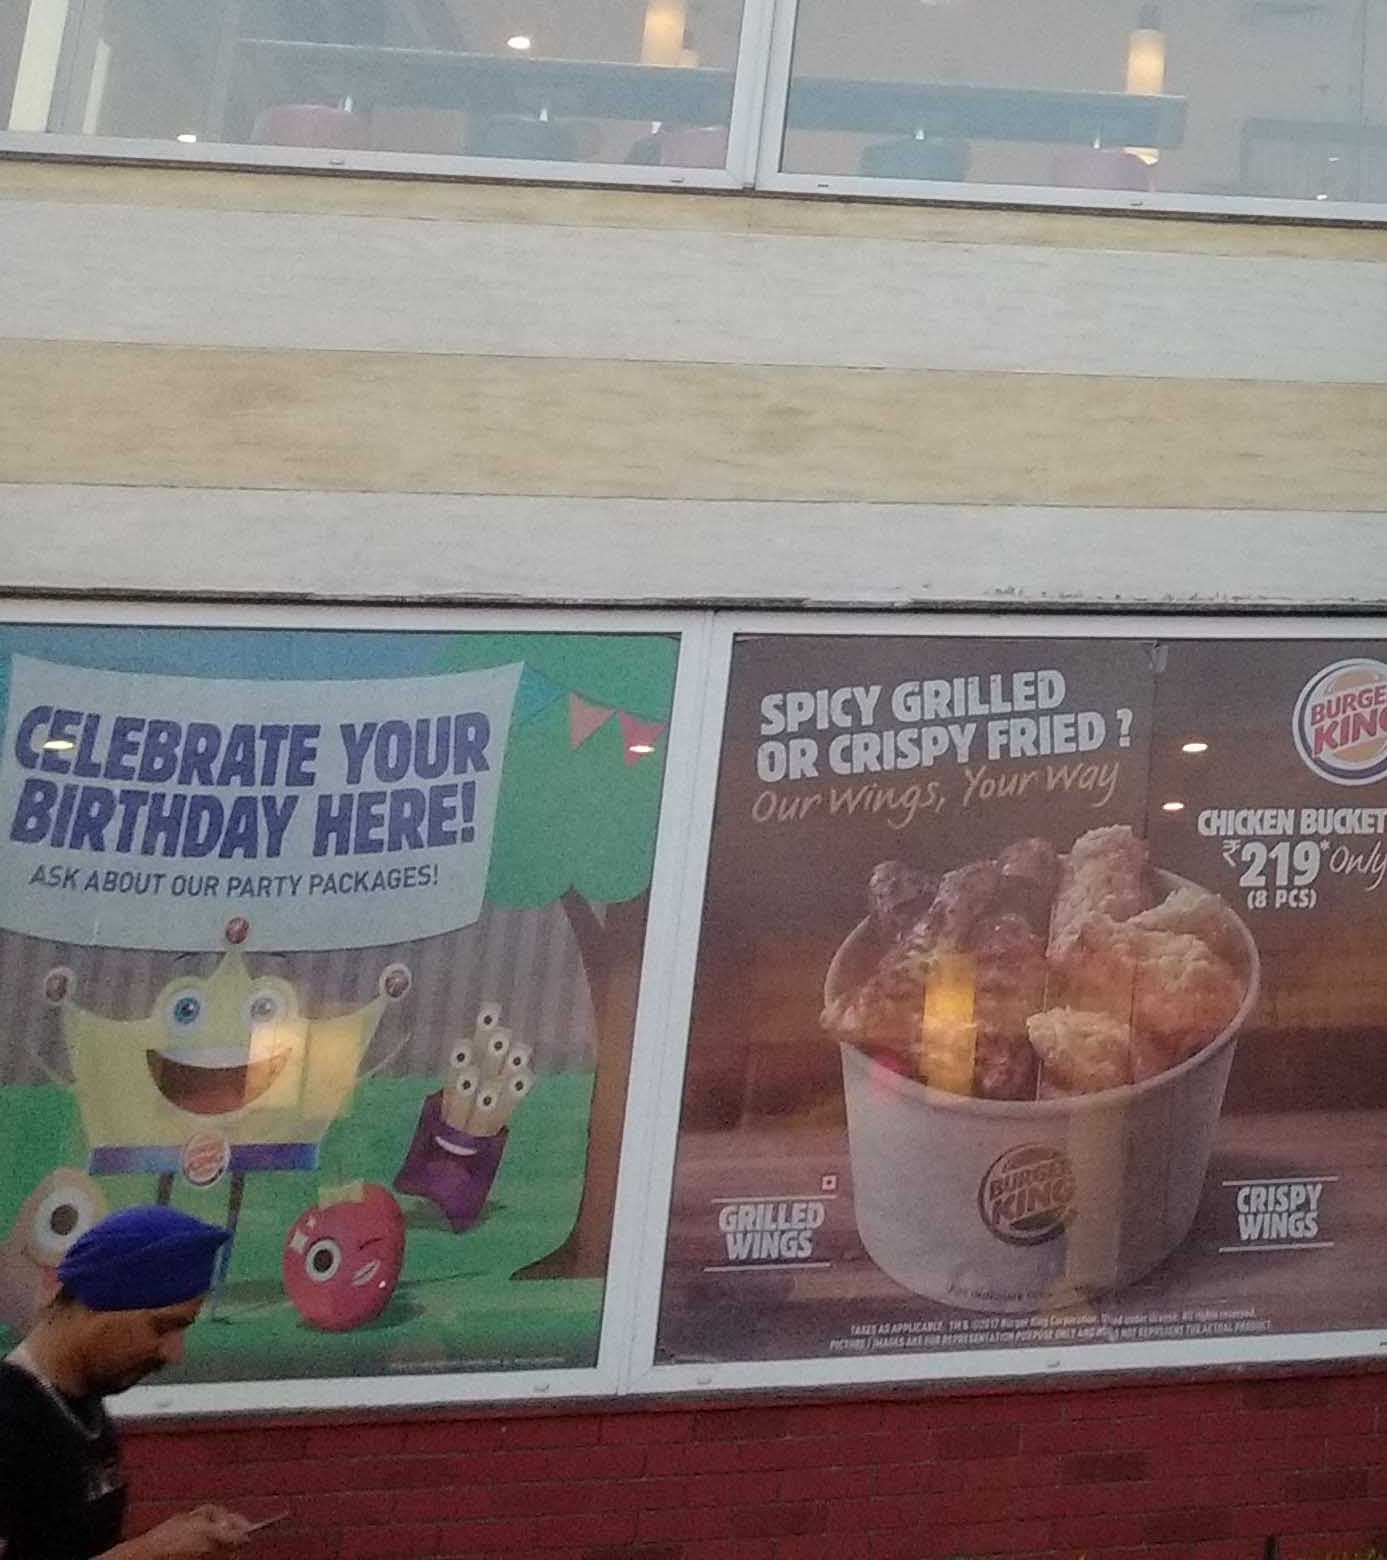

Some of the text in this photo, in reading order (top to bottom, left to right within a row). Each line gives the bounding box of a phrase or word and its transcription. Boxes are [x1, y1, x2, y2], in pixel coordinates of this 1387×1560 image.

[760, 669, 1066, 735] SPICY GRILLED
[14, 704, 491, 787] CELEBRATE YOUR
[757, 738, 818, 783] OR
[829, 722, 977, 775] CRISPY
[988, 712, 1106, 761] FRIED
[751, 790, 821, 824] Our
[962, 766, 1037, 807] Your
[10, 778, 476, 859] BIRTHDAY HERE!
[1198, 808, 1295, 836] CHICKEN
[1300, 807, 1387, 834] BUCKET
[29, 864, 440, 897] ASK ABOUT OUR PARTY PACKAGES!
[1247, 889, 1317, 909] (8 PCS)
[1237, 1184, 1322, 1213] CRISPY
[719, 1201, 825, 1232] GRILLED
[1238, 1211, 1319, 1240] WINGS
[725, 1230, 813, 1260] WINGS
